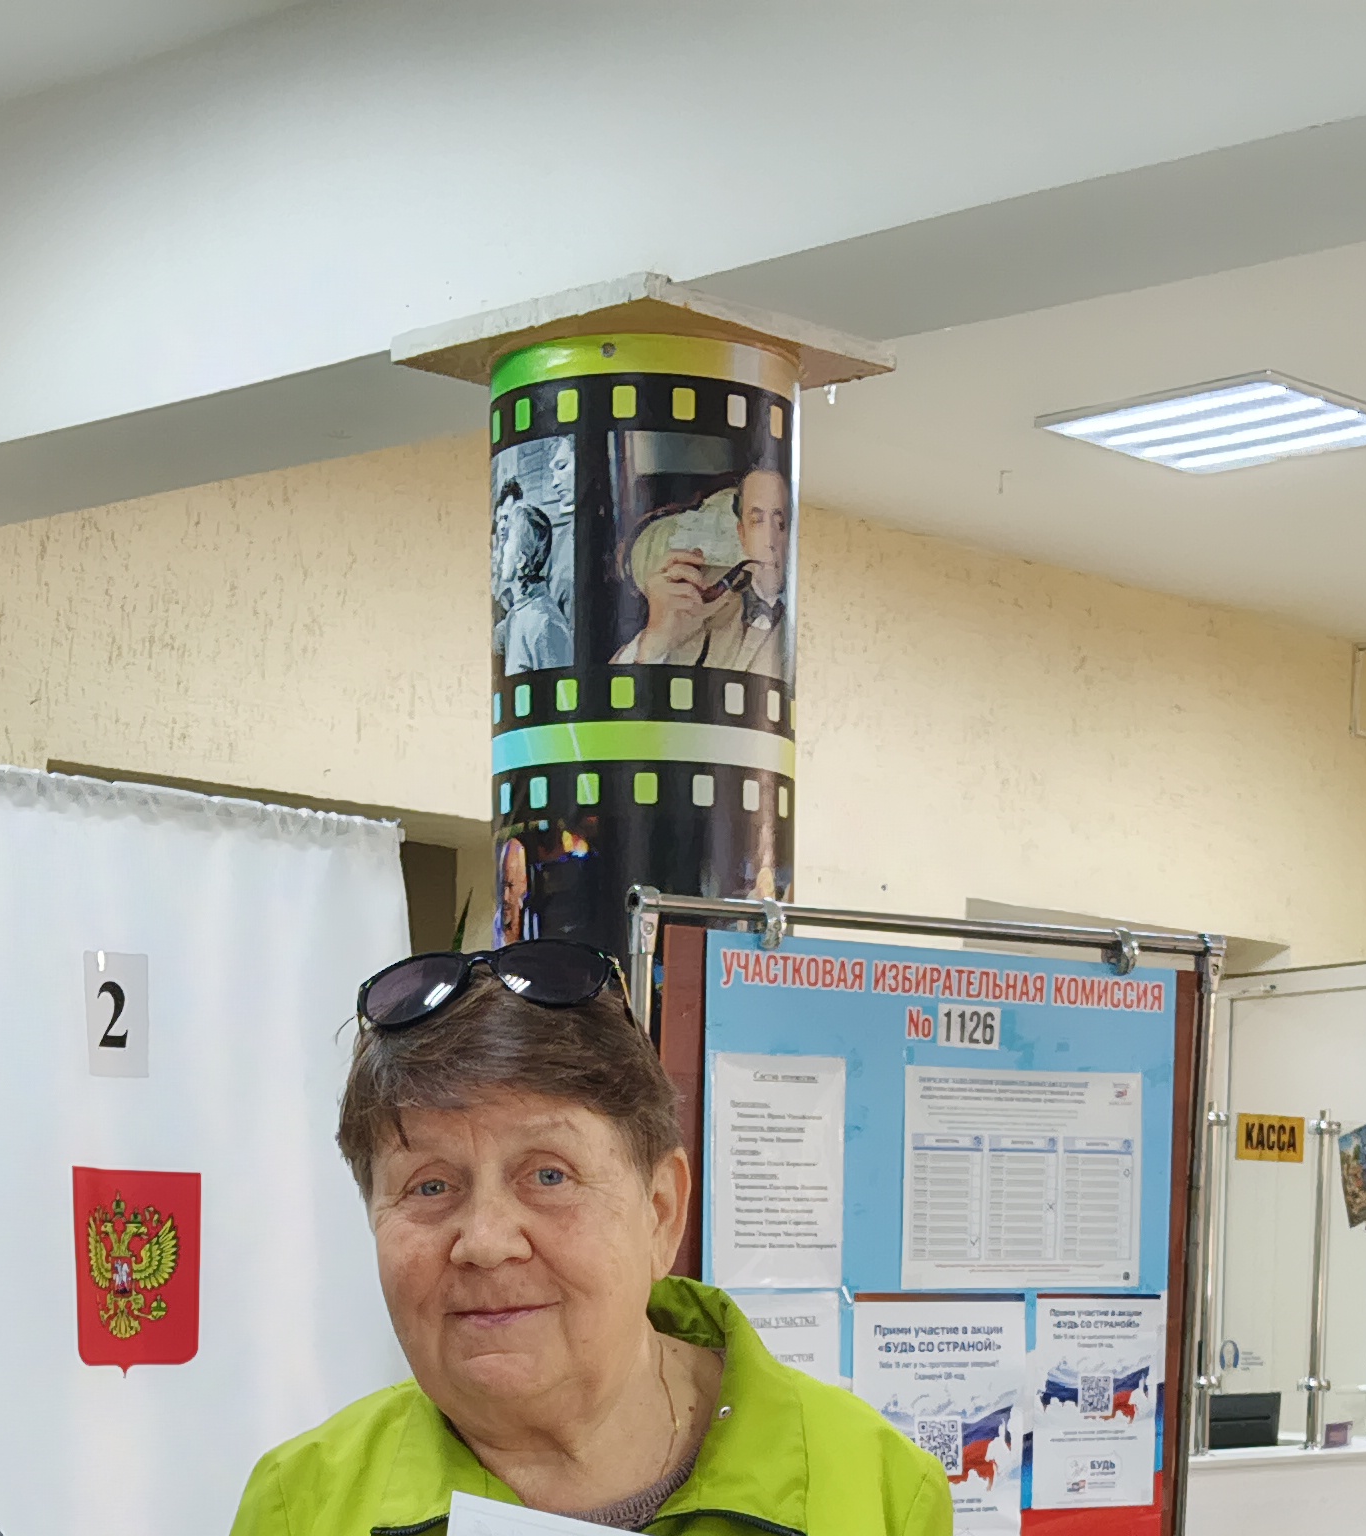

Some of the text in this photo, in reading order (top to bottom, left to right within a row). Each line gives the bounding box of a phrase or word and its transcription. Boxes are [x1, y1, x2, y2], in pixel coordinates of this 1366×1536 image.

[722, 950, 1163, 1012] УЧАСТКОВАЯ ИЗБИРАТЕЛЬНАЯ КОМИССИЯ
[97, 980, 129, 1049] 2
[944, 1008, 995, 1045] 1126
[1245, 1121, 1297, 1153] КАССА
[874, 1324, 911, 1338] Прими
[914, 1325, 959, 1338] участие
[971, 1326, 1003, 1337] акции
[878, 1338, 1002, 1353] «БУДЬ СО СТРАНОЙ!»
[1090, 1460, 1116, 1471] БУДЬ
